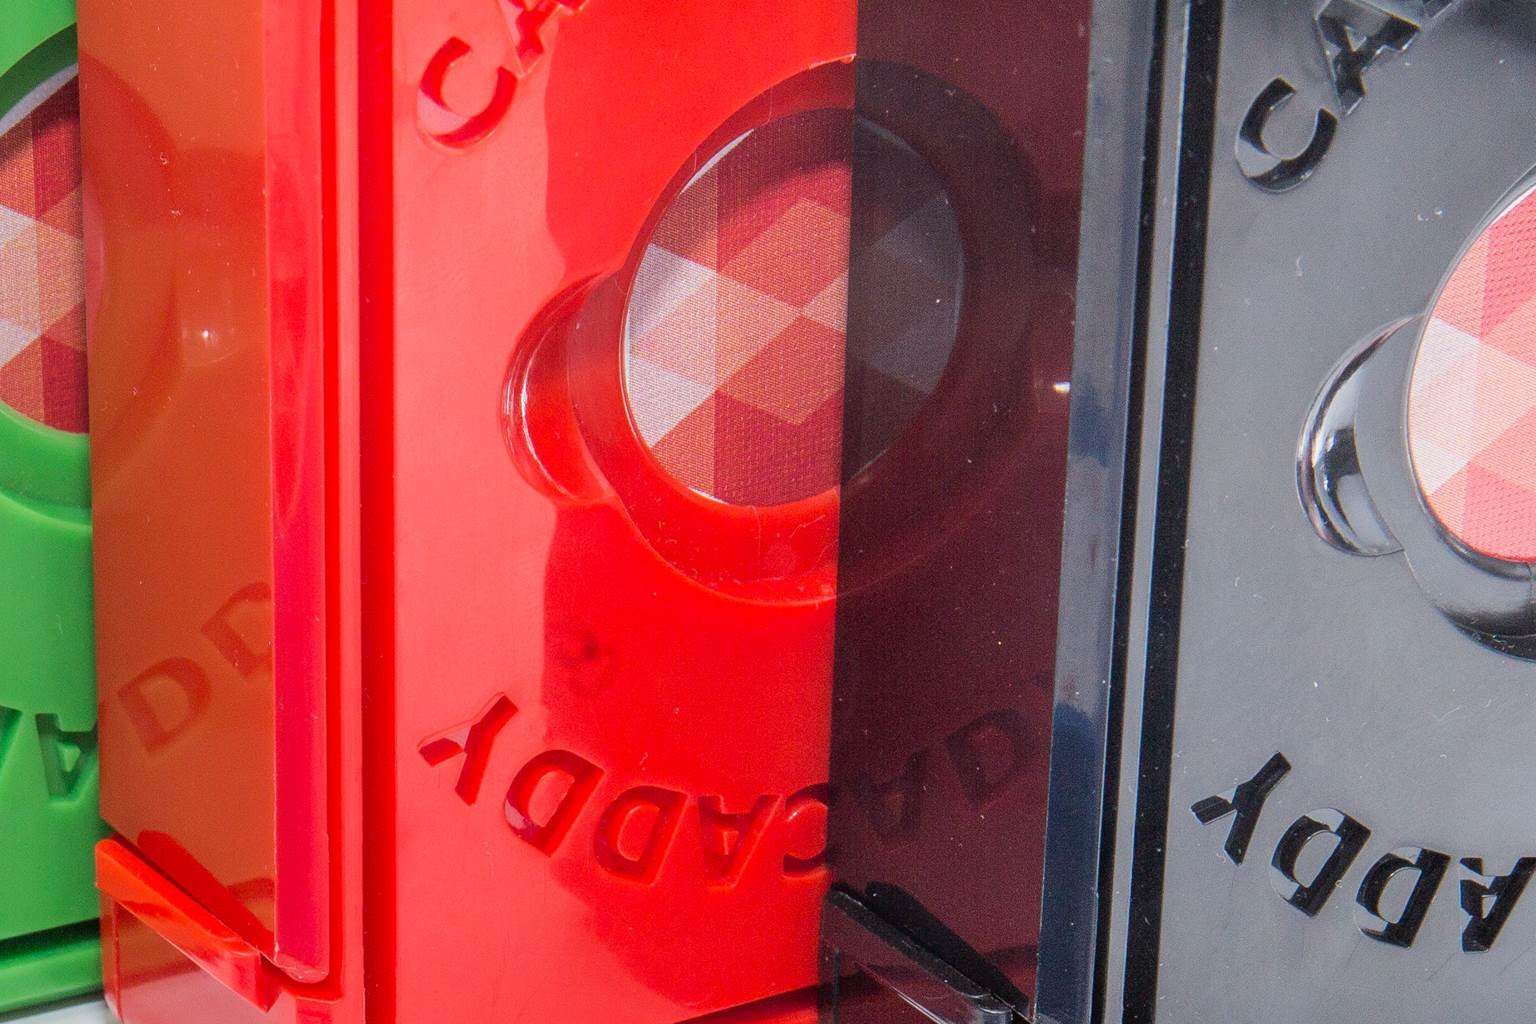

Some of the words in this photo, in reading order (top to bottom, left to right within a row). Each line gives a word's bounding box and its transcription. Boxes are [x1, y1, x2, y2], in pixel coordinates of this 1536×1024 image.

[416, 0, 587, 150] CA
[1235, 0, 1449, 193] CA
[1190, 752, 1536, 952] ADDY
